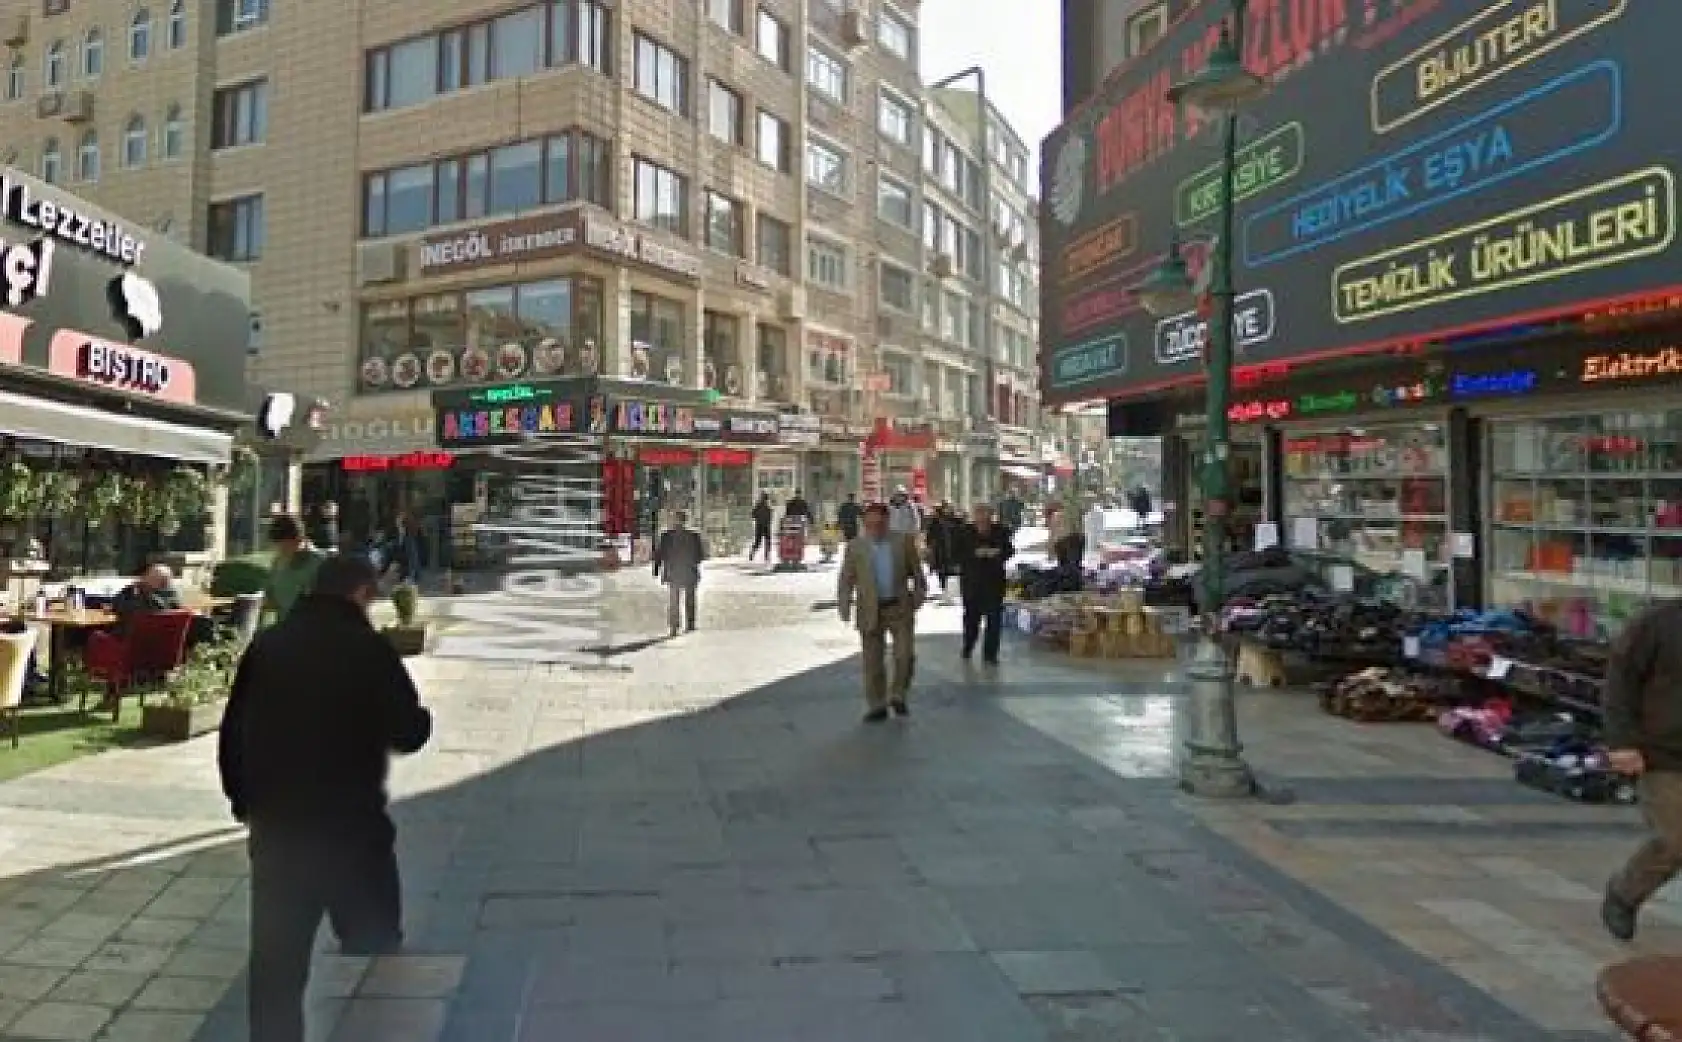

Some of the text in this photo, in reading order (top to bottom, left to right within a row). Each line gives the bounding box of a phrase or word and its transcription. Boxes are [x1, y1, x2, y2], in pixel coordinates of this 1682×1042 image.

[1423, 124, 1514, 191] EŞYA
[1340, 184, 1657, 312] TEMİZLİK ÜRÜNLERİ
